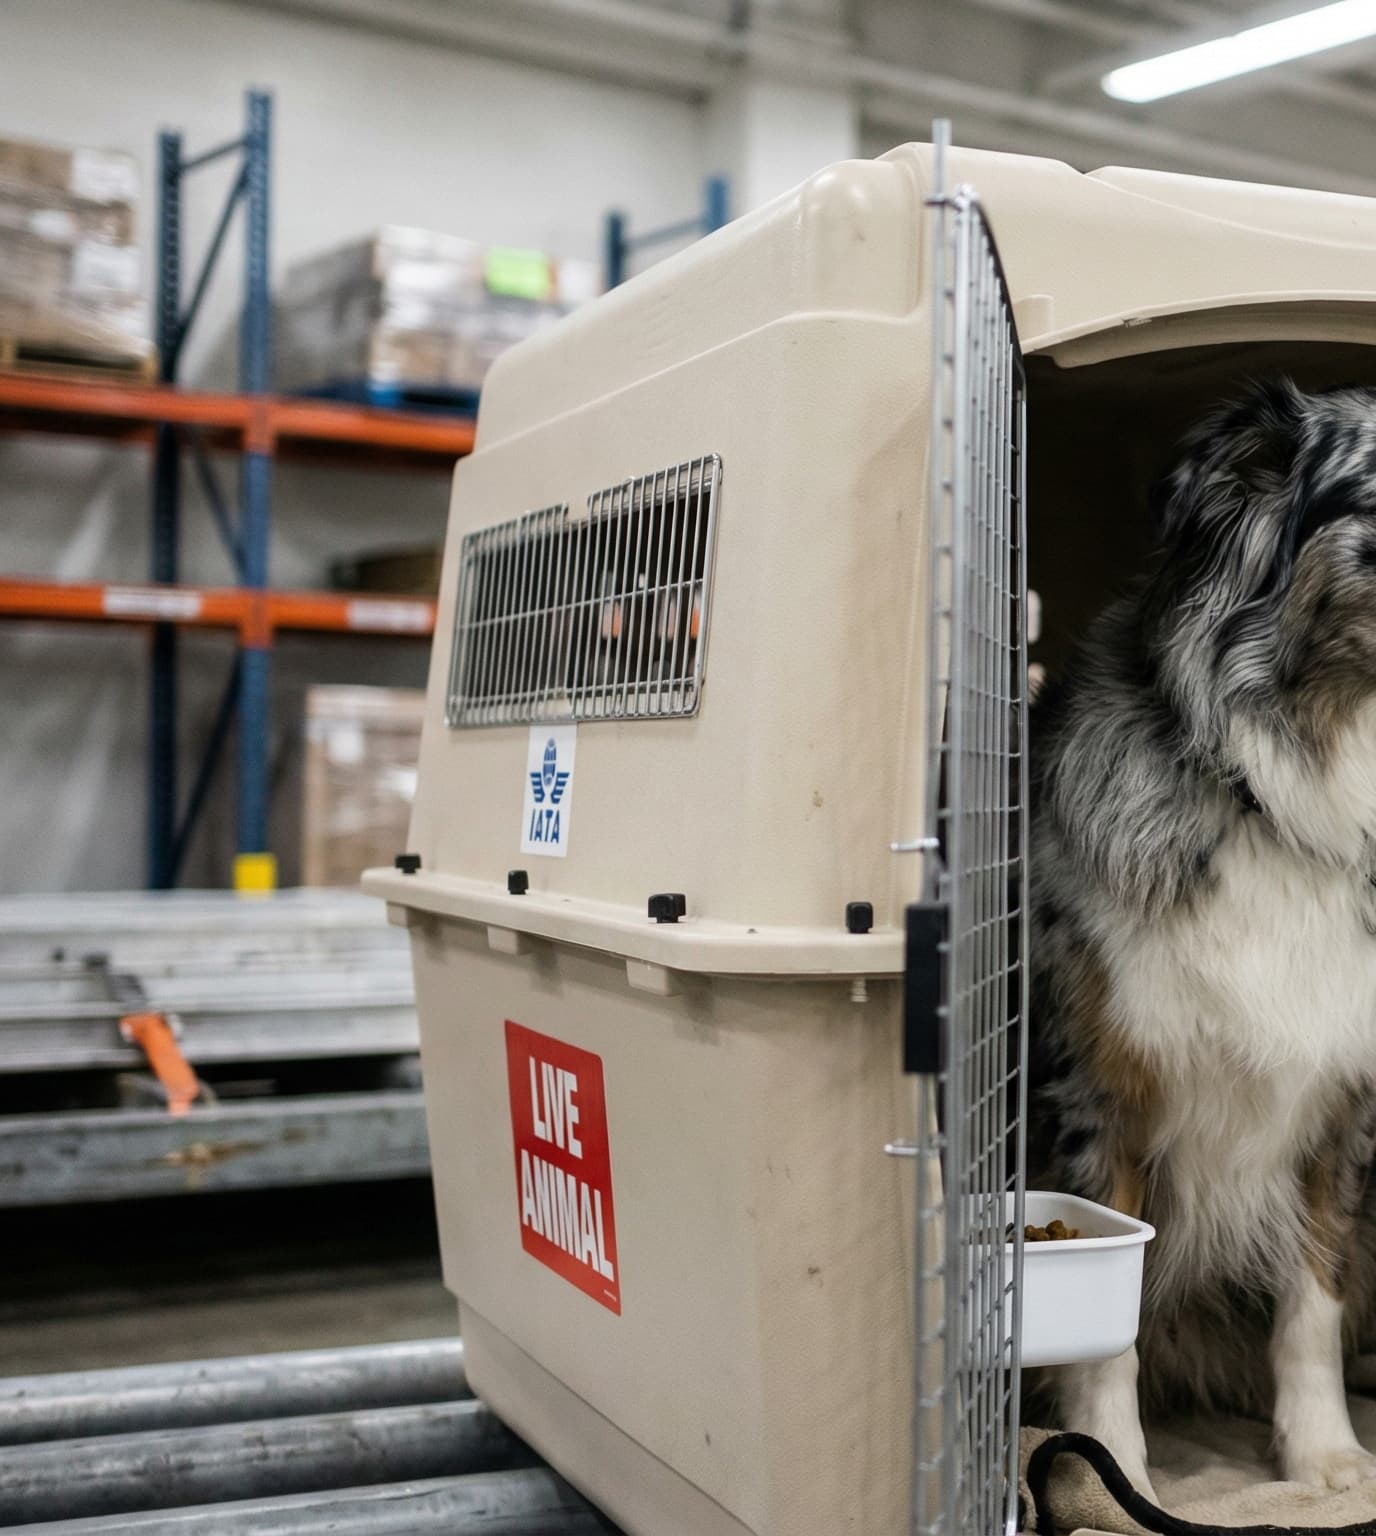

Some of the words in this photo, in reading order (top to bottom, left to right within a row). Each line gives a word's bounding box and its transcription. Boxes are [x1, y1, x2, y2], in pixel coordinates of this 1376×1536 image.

[529, 808, 560, 844] IATA
[529, 1055, 582, 1159] LIVE
[521, 1148, 614, 1282] ANIMAL
